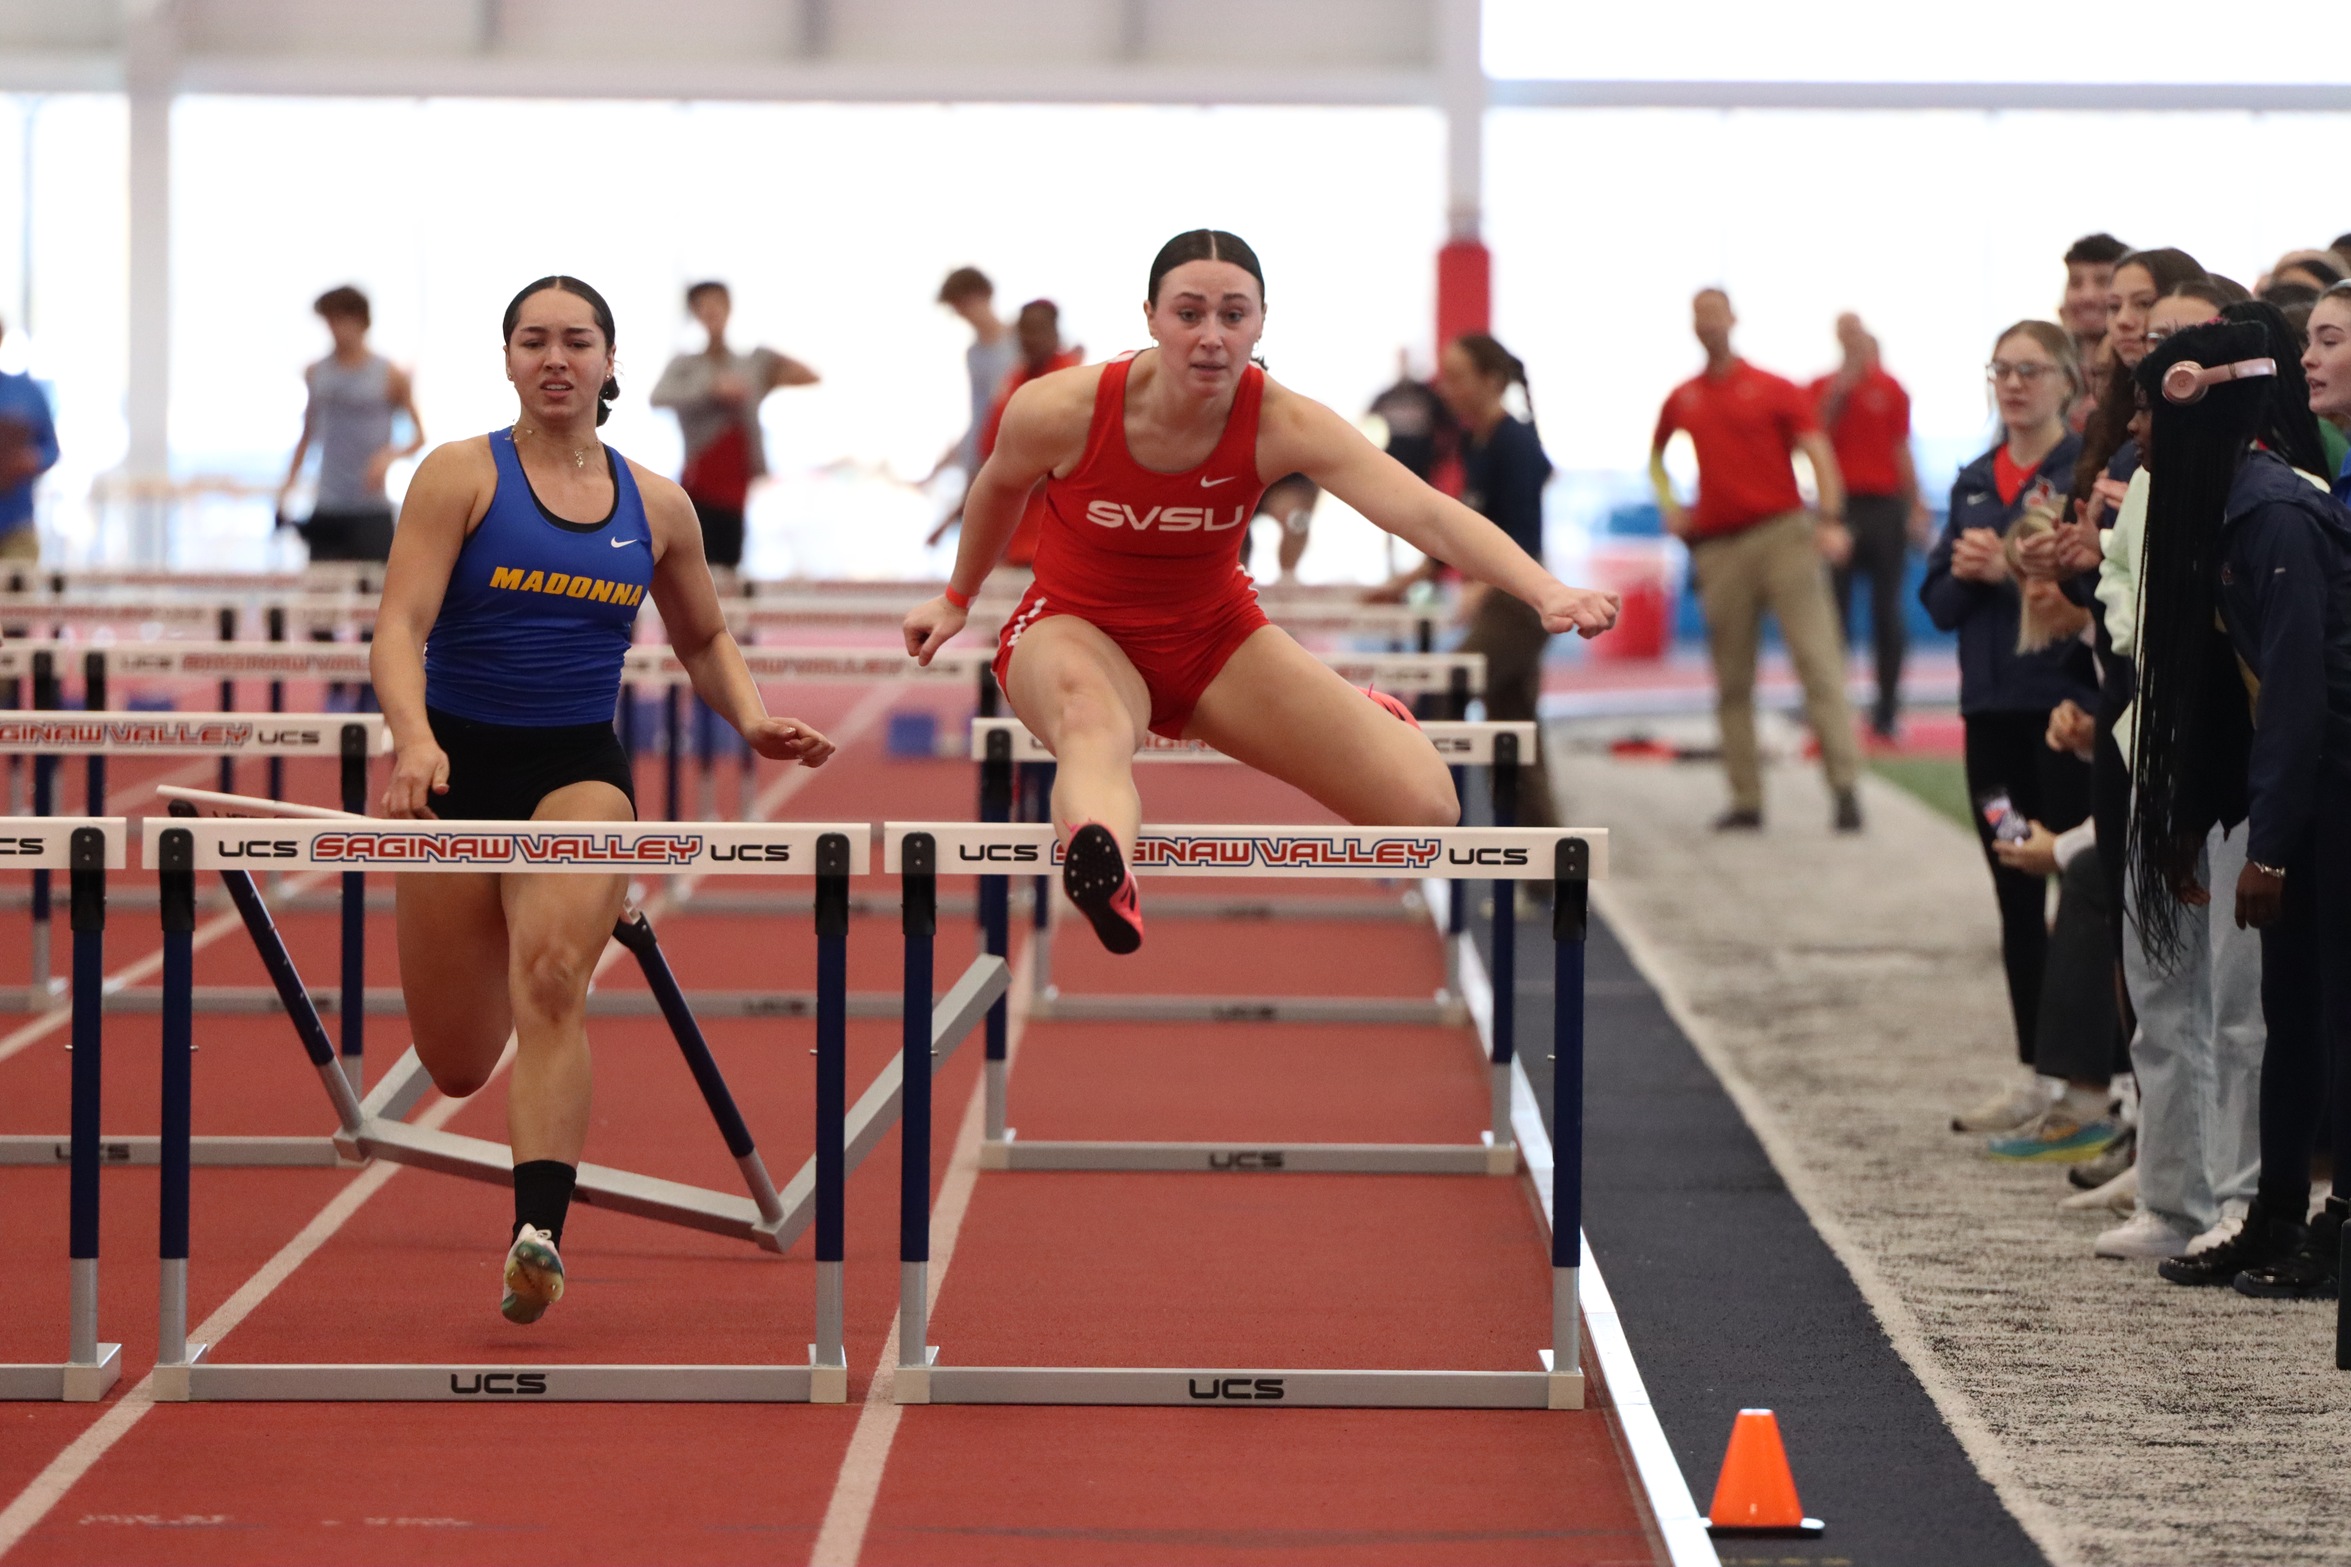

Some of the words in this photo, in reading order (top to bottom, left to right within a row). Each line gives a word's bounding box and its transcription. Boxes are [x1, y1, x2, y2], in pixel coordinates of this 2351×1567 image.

[1086, 500, 1244, 532] SVSU
[489, 566, 643, 607] MADONNA
[108, 722, 251, 745] VALLEY
[258, 730, 321, 745] UCS
[0, 837, 45, 855] CS
[218, 840, 299, 858] UCS
[313, 835, 515, 862] SAGINAW
[516, 836, 701, 863] VALLEY
[710, 844, 790, 862] UCS
[959, 844, 1039, 862] UCS
[1256, 839, 1440, 867] VALLEY
[1448, 848, 1529, 866] UCS
[1210, 1151, 1284, 1169] UCS
[451, 1373, 548, 1394] UCS
[1188, 1378, 1285, 1399] UCS
